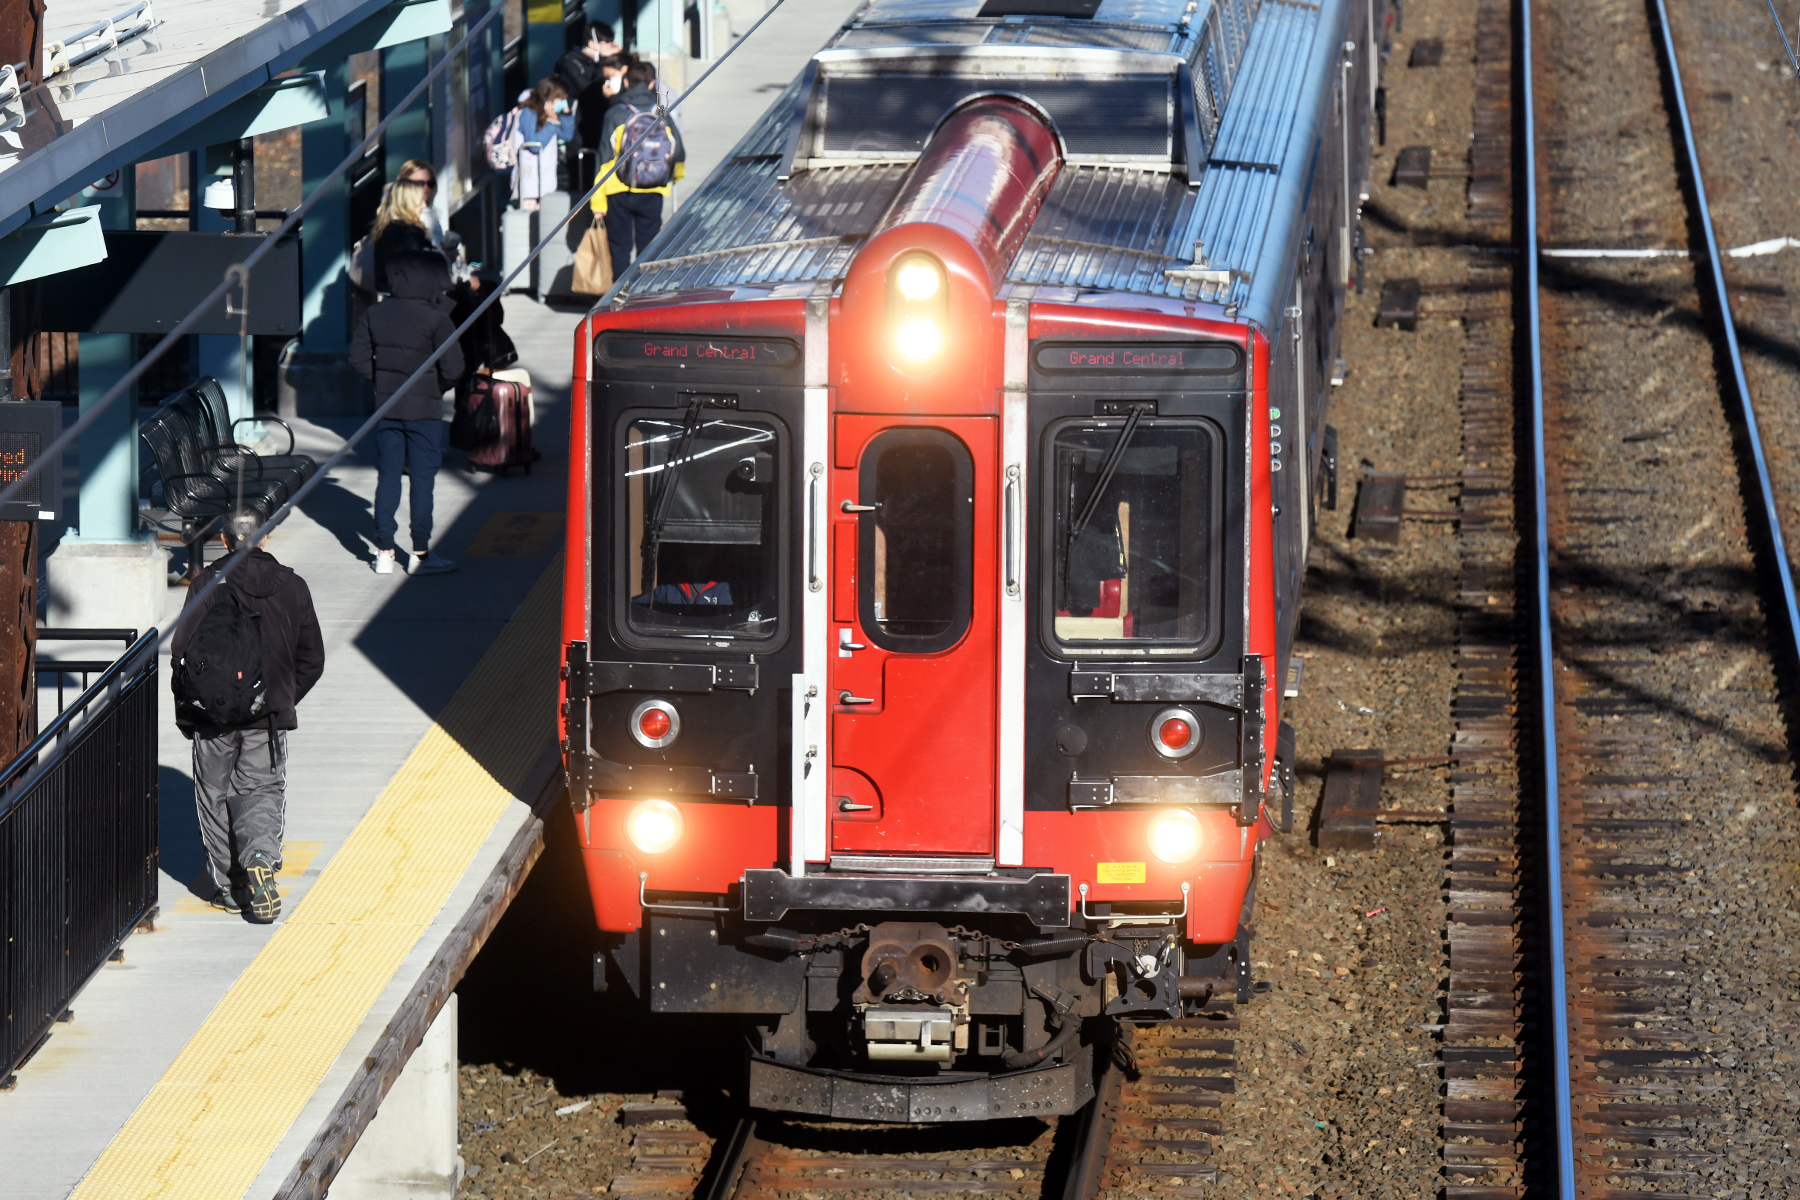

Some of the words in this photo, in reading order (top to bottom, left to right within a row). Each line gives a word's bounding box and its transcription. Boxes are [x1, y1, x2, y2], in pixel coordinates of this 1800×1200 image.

[644, 342, 688, 358] Grand
[696, 344, 756, 360] Central
[1069, 351, 1115, 365] Grand
[1122, 351, 1184, 366] Central
